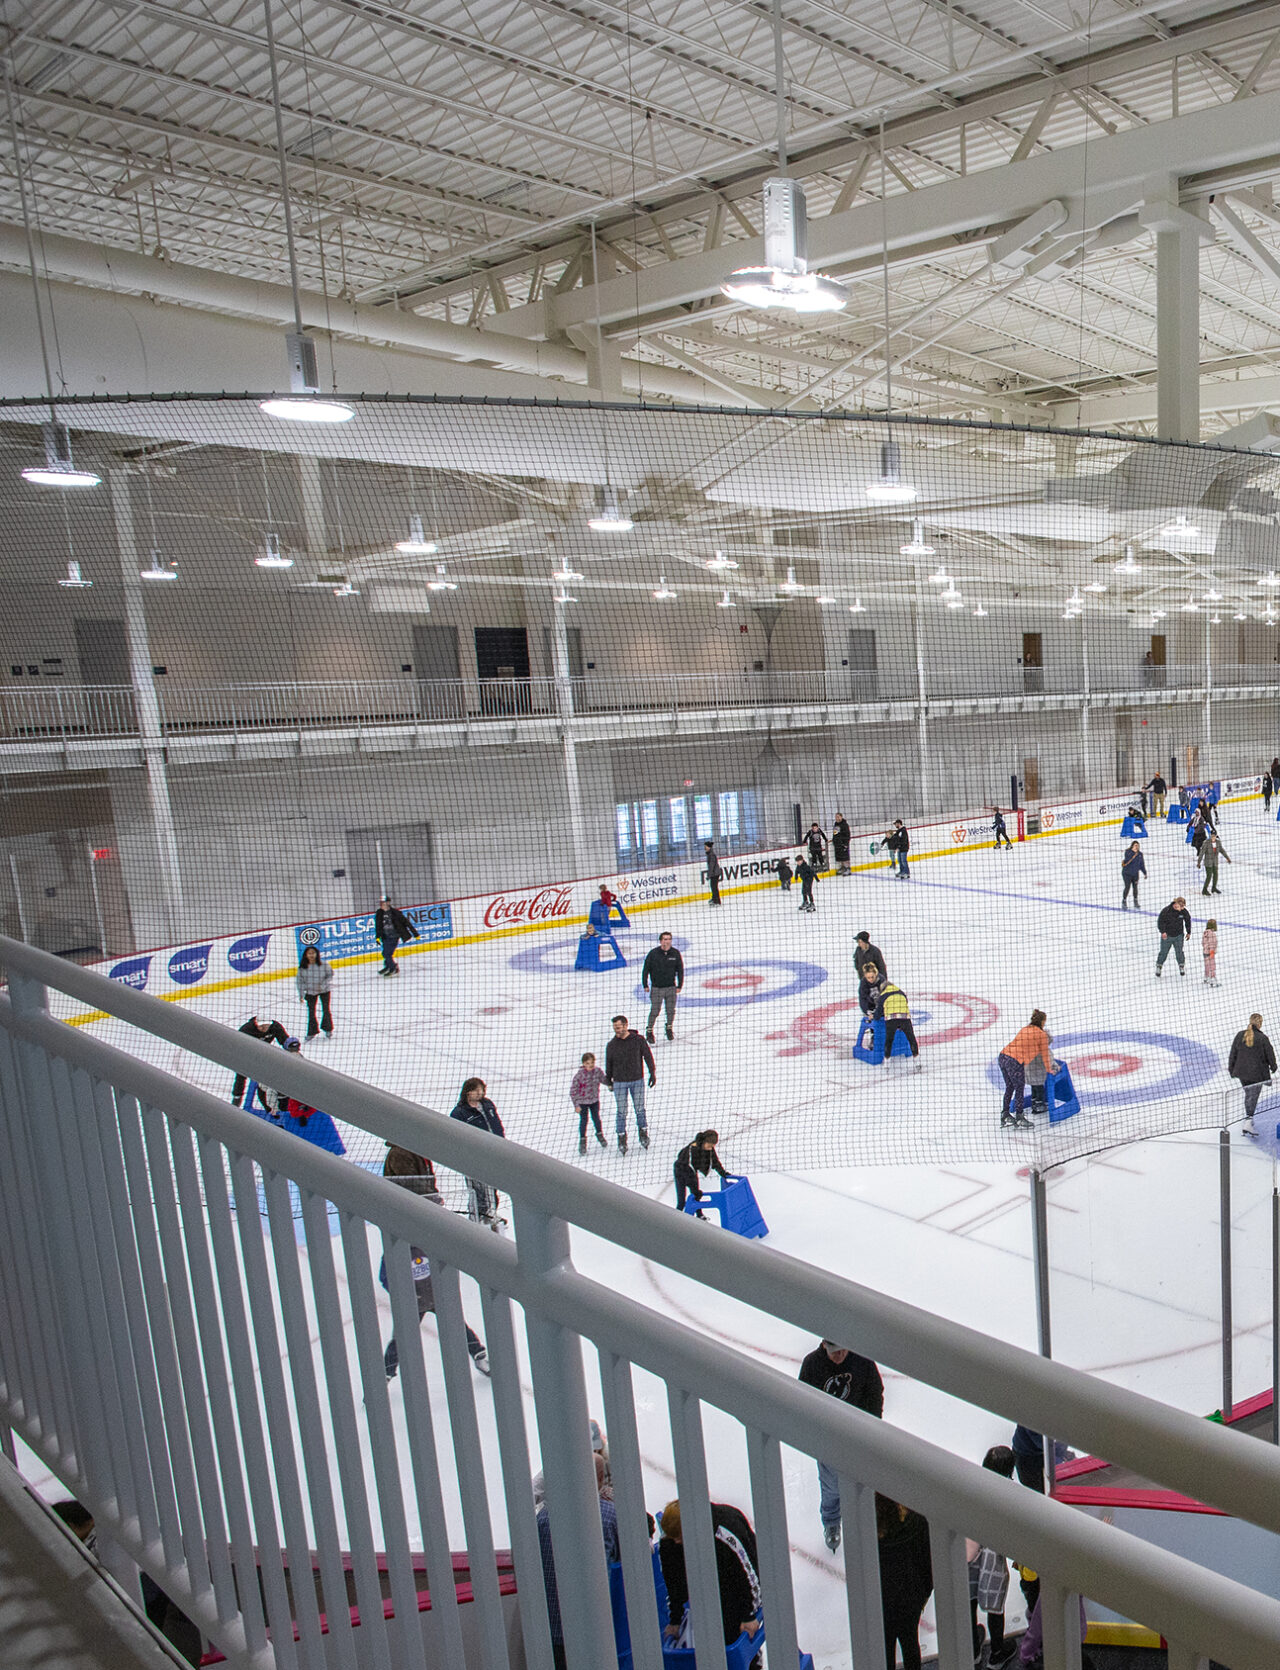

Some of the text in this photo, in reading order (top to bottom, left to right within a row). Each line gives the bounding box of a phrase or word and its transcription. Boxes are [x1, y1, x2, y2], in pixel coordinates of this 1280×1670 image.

[967, 825, 993, 836] WeStre
[631, 873, 677, 888] WeStreet
[620, 886, 678, 904] ICE CENTER
[483, 886, 575, 928] Coca-Cola
[320, 917, 376, 939] TULSA
[229, 945, 266, 962] smart
[168, 956, 207, 974] smart
[114, 968, 147, 983] mart
